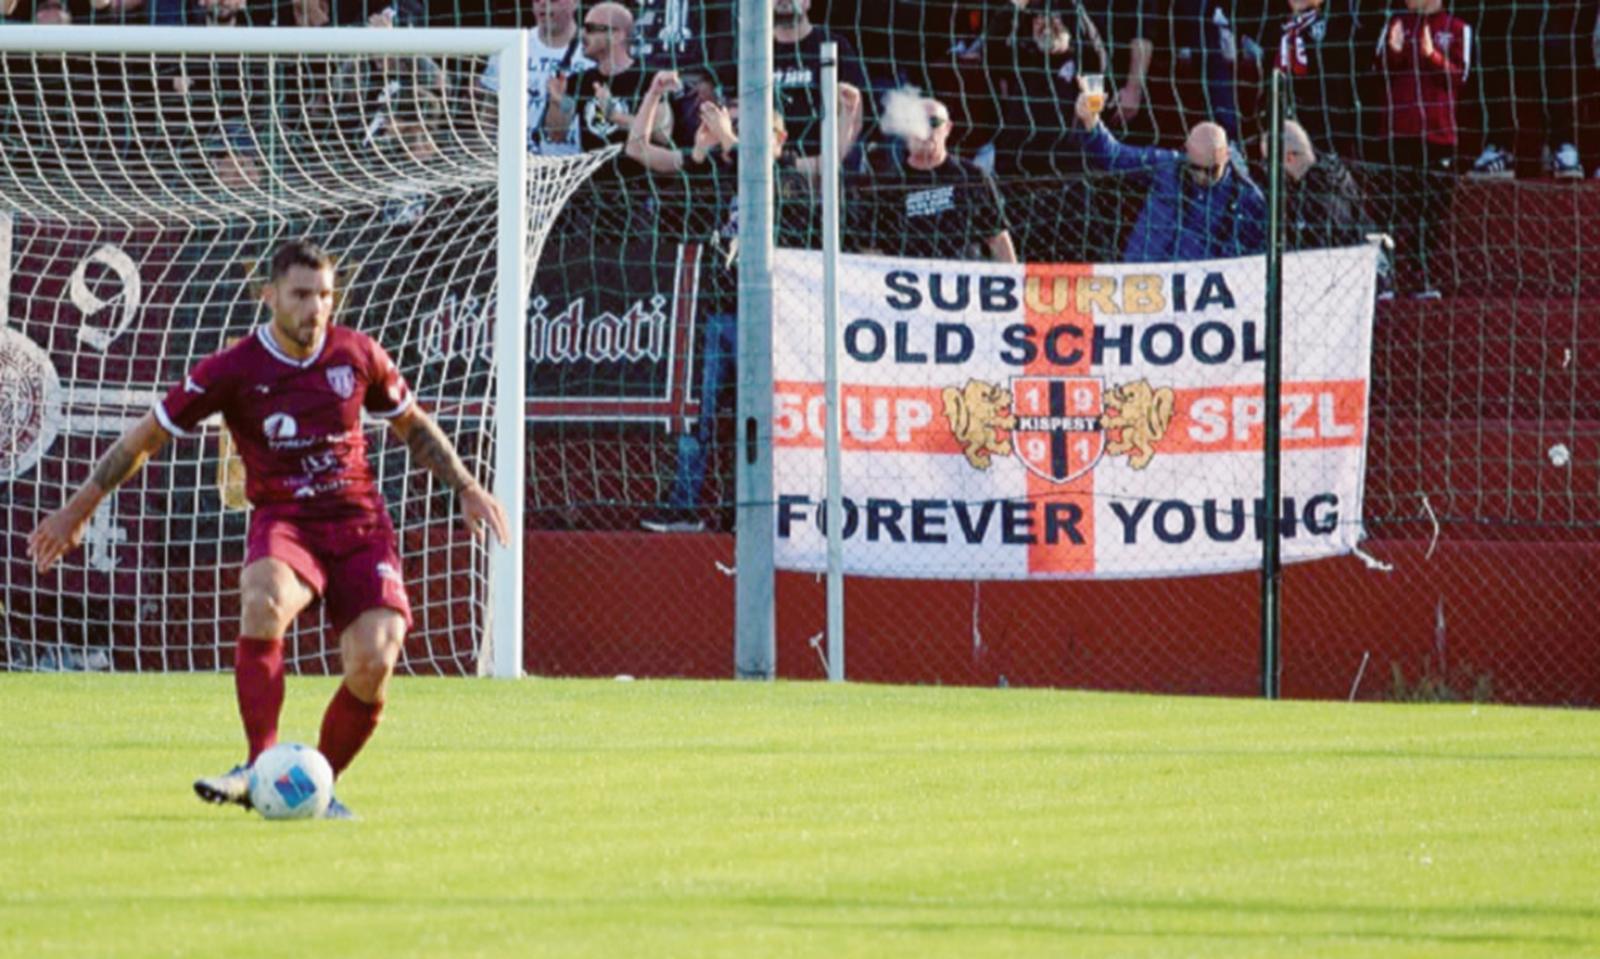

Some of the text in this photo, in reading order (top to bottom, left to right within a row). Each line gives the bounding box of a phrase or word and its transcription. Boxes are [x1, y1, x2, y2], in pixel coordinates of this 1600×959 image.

[884, 270, 1236, 315] SUBURBIA
[844, 318, 1266, 367] OLD SCHOOL
[1025, 387, 1094, 414] 1 9
[1187, 391, 1356, 444] SPZL
[1019, 416, 1097, 431] KISPEST
[1027, 438, 1090, 464] 9 1
[777, 493, 1340, 546] FOREVER YOUNG
